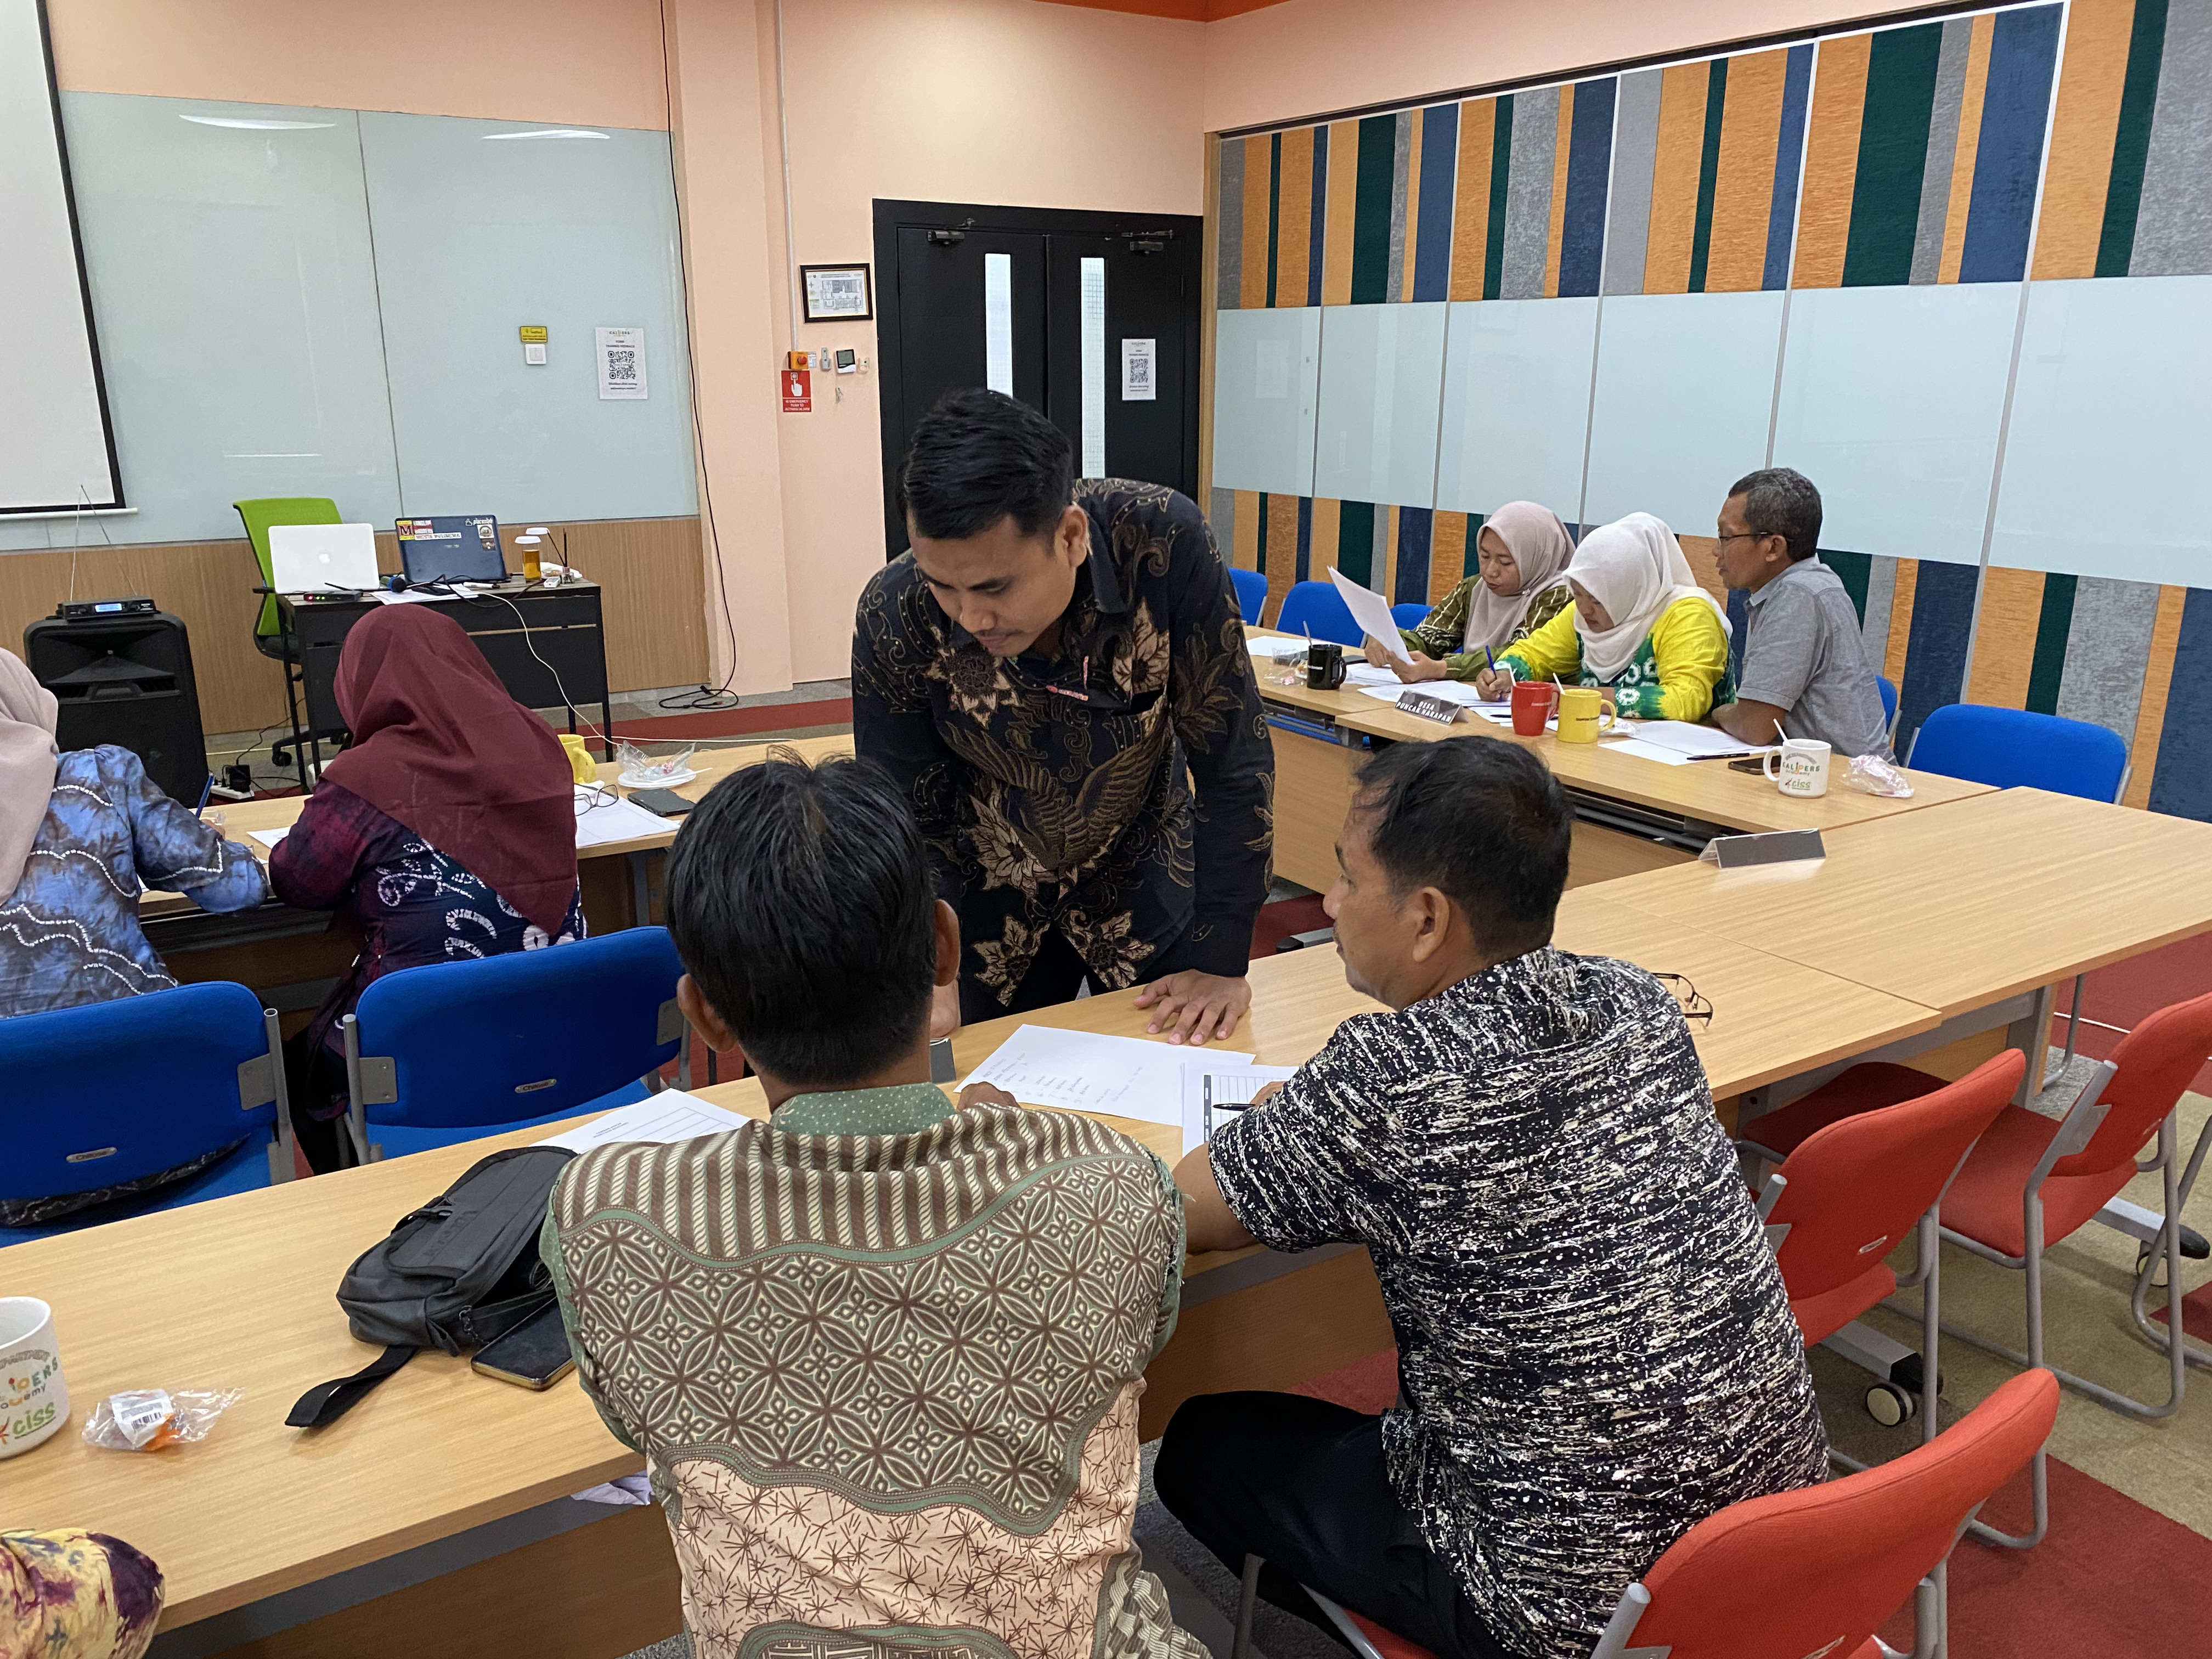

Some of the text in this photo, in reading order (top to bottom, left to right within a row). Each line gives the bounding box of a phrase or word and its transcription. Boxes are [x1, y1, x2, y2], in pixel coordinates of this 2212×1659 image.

[1396, 701, 1452, 723] PUNCAK HARAPAN
[1418, 701, 1435, 711] DESA
